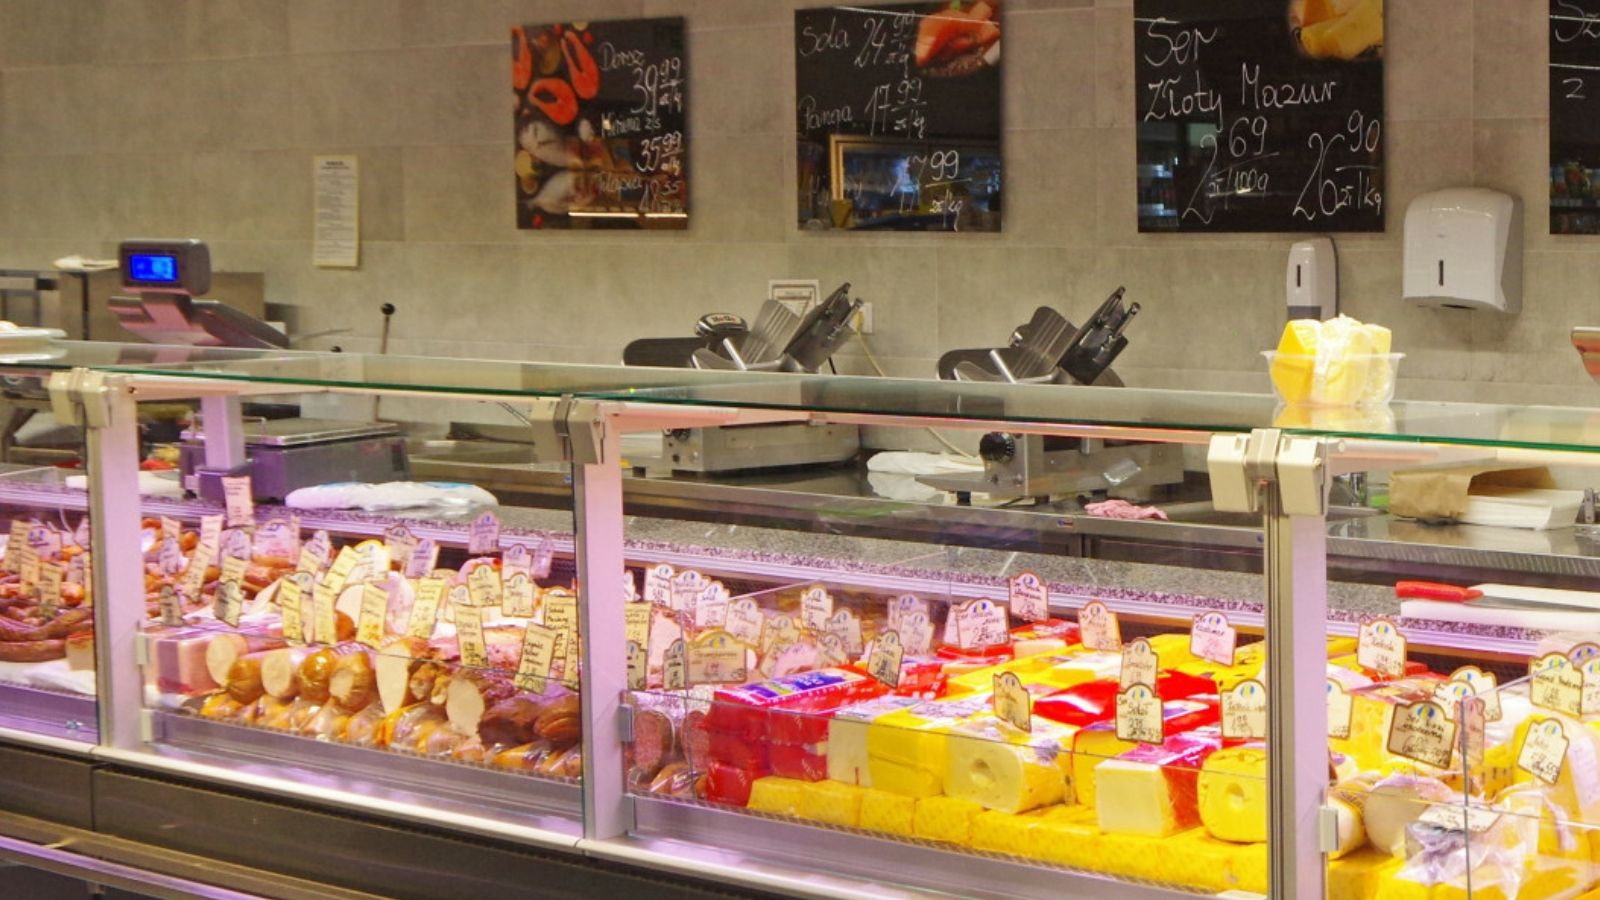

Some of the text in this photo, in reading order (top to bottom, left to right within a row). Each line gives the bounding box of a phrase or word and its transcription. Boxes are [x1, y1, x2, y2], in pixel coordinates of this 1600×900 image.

[854, 17, 888, 68] 24
[1144, 16, 1218, 67] Ser
[1241, 61, 1337, 110] Mazur
[929, 150, 960, 182] 99
[1181, 115, 1269, 225] 2 69
[1292, 109, 1381, 222] 26 90
